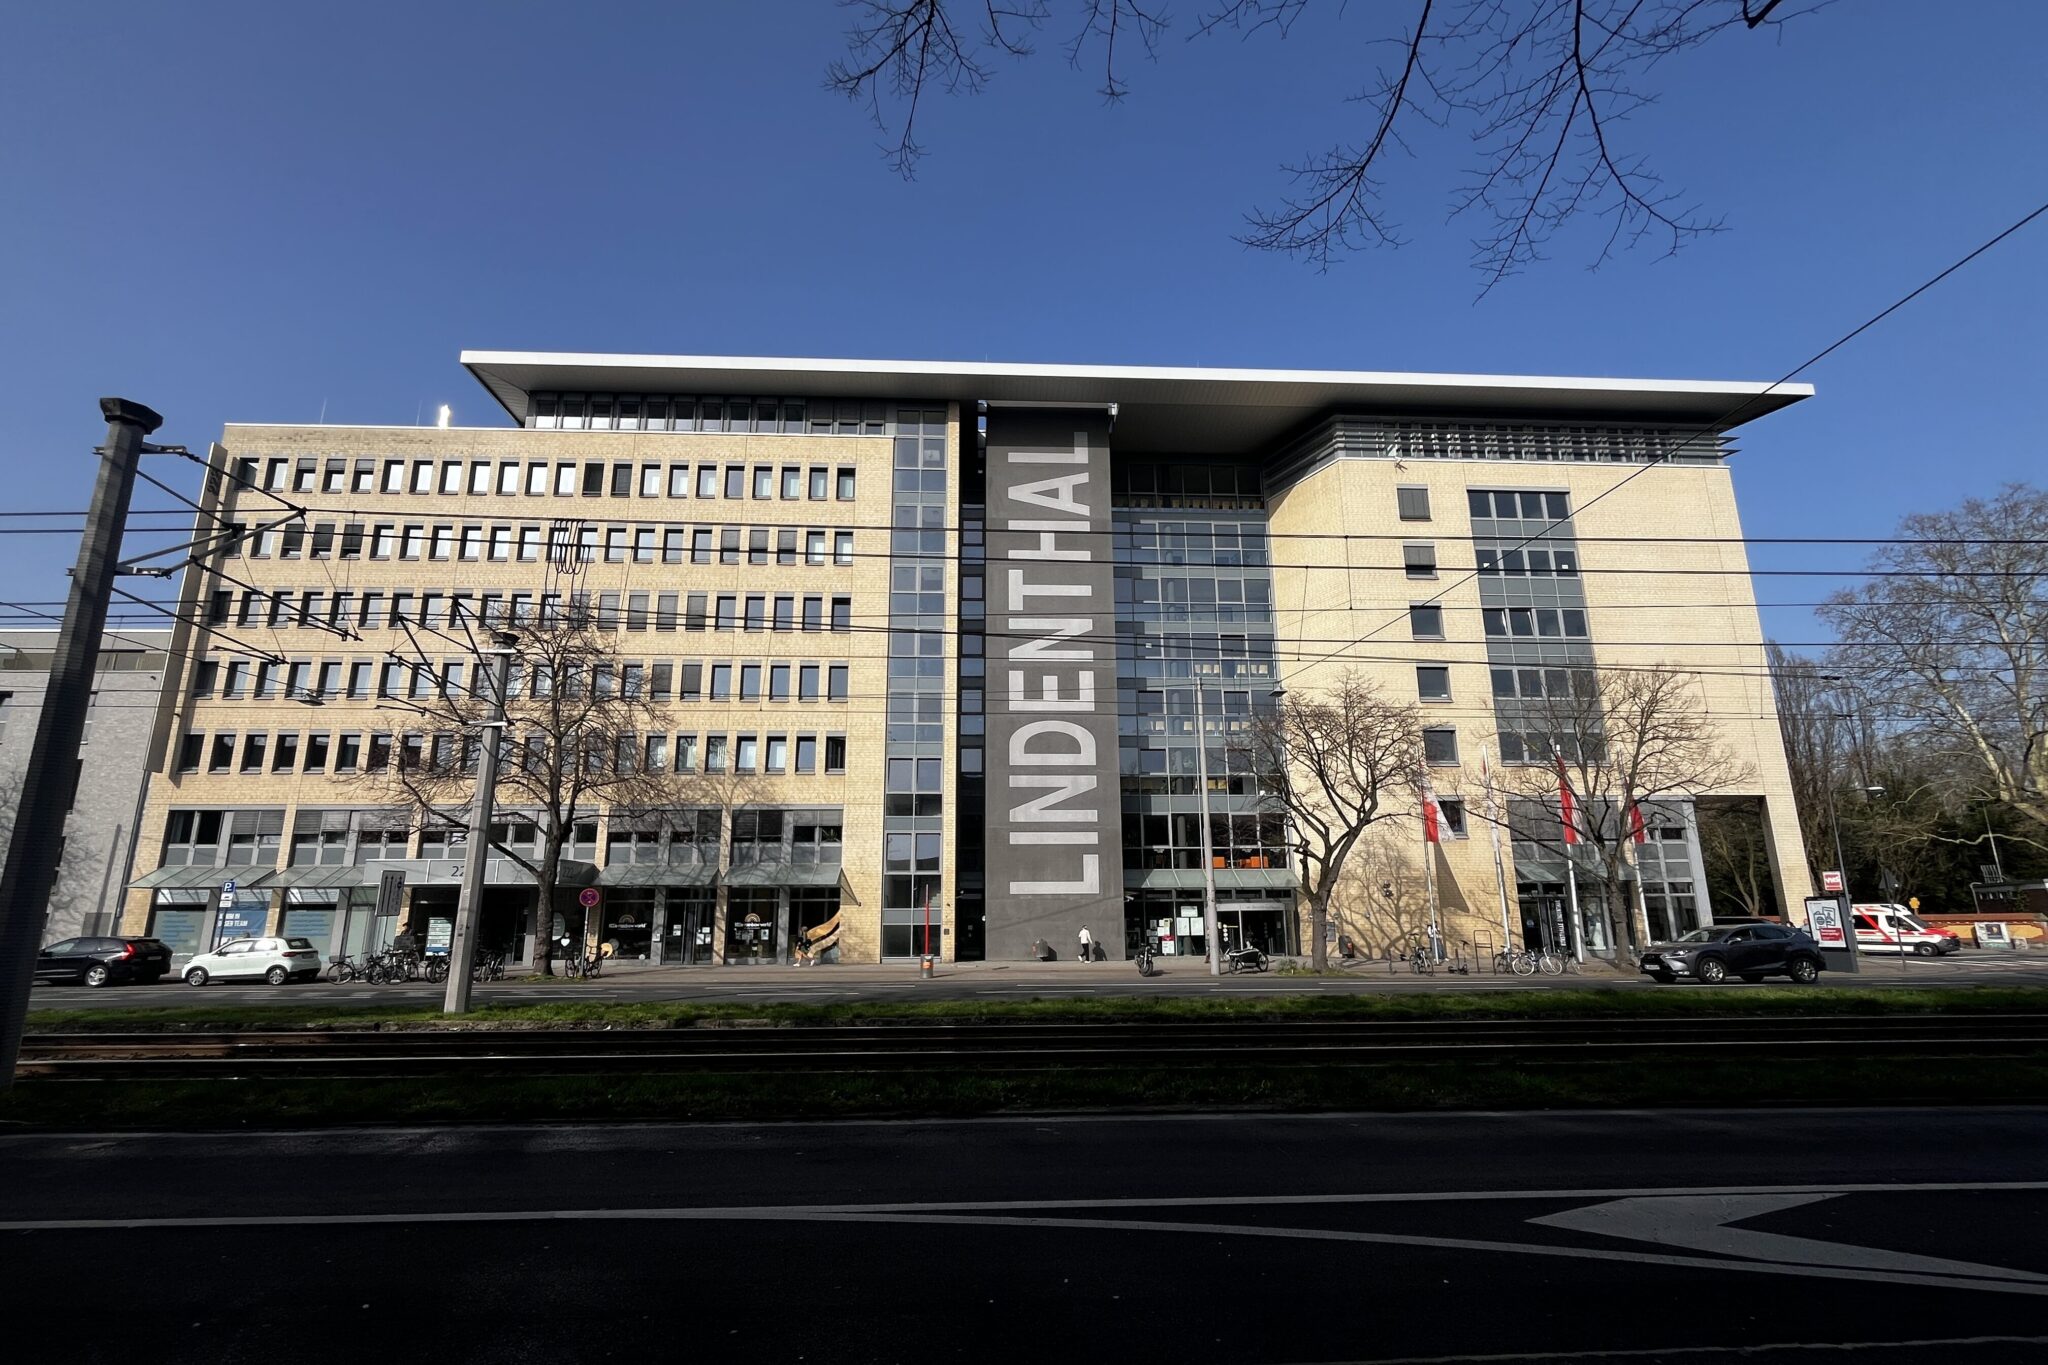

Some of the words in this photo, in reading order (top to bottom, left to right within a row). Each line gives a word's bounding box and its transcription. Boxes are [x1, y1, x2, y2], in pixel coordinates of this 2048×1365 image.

[1007, 431, 1100, 895] LINDENTHAL
[451, 866, 465, 877] 22
[224, 882, 232, 892] P
